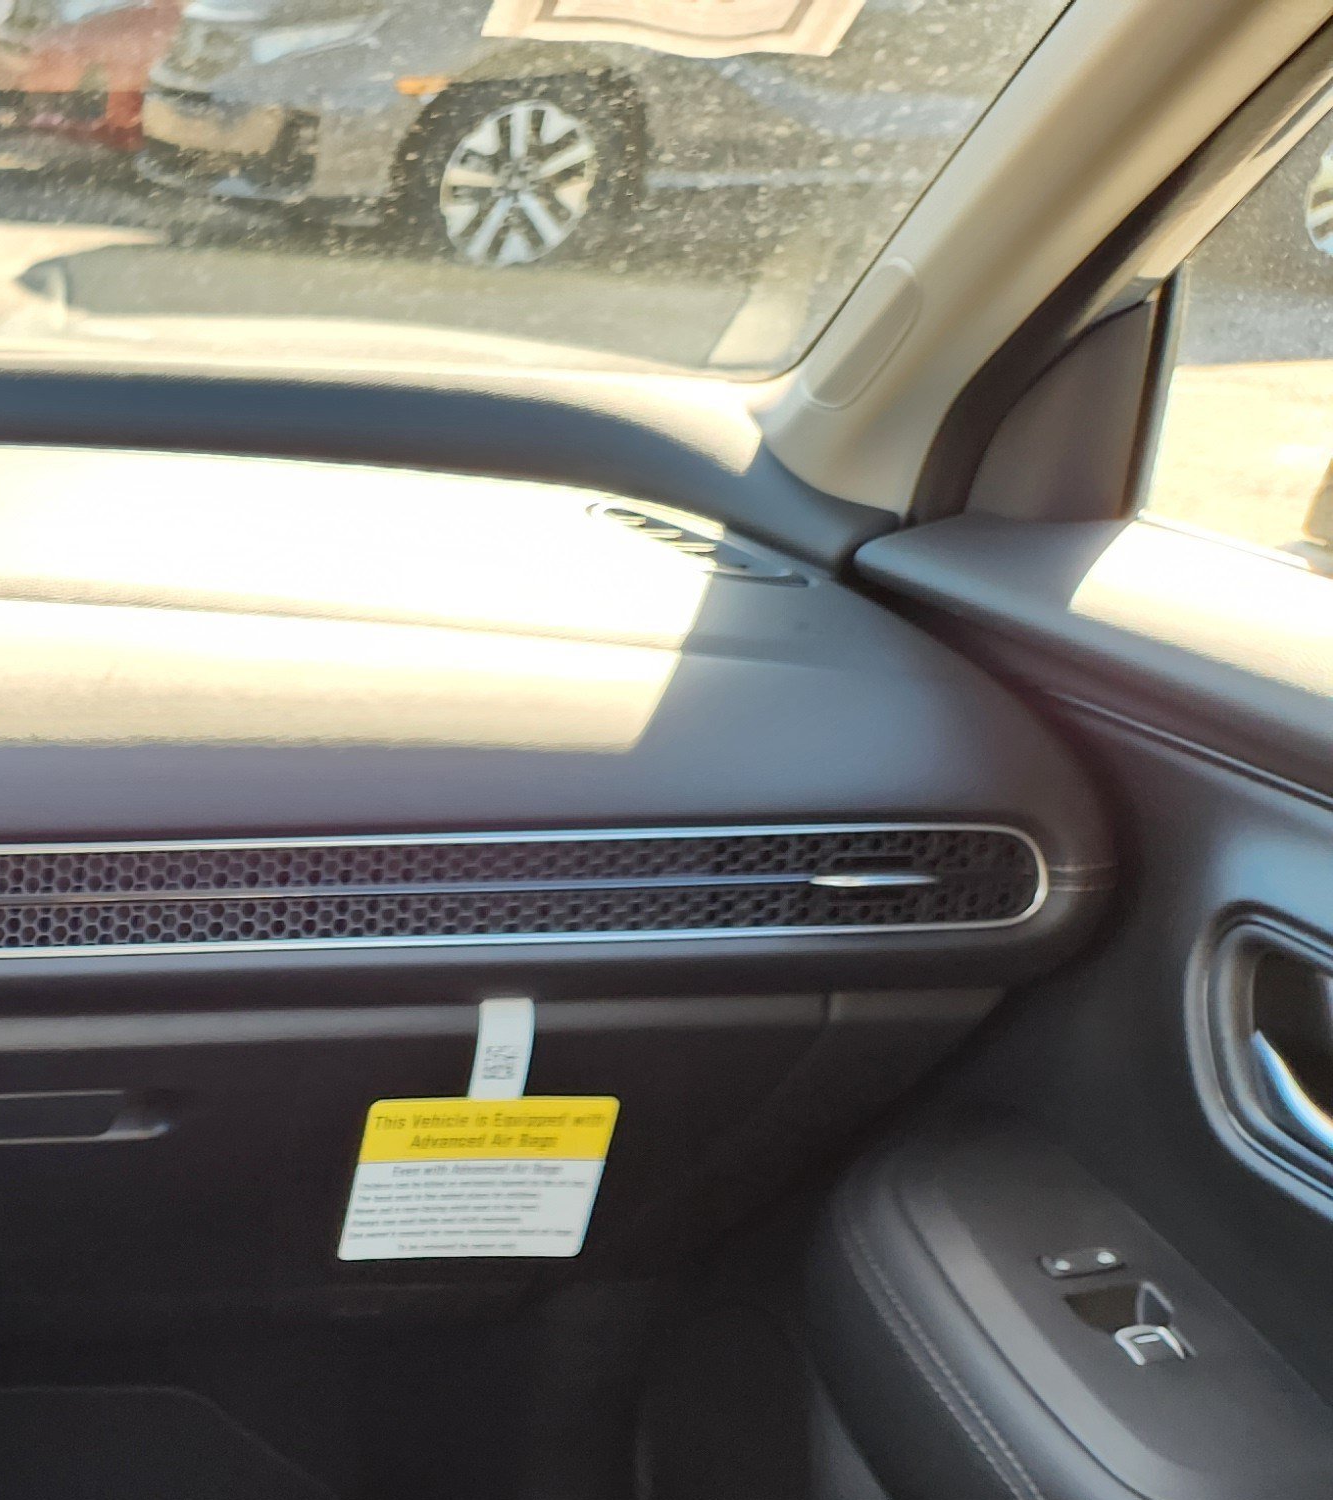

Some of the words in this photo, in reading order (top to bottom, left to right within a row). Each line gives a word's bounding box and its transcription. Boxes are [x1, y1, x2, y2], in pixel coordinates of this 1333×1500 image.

[374, 1115, 406, 1130] This
[412, 1114, 469, 1130] Vehicle
[409, 1133, 486, 1150] Advanced
[490, 1133, 513, 1147] Air
